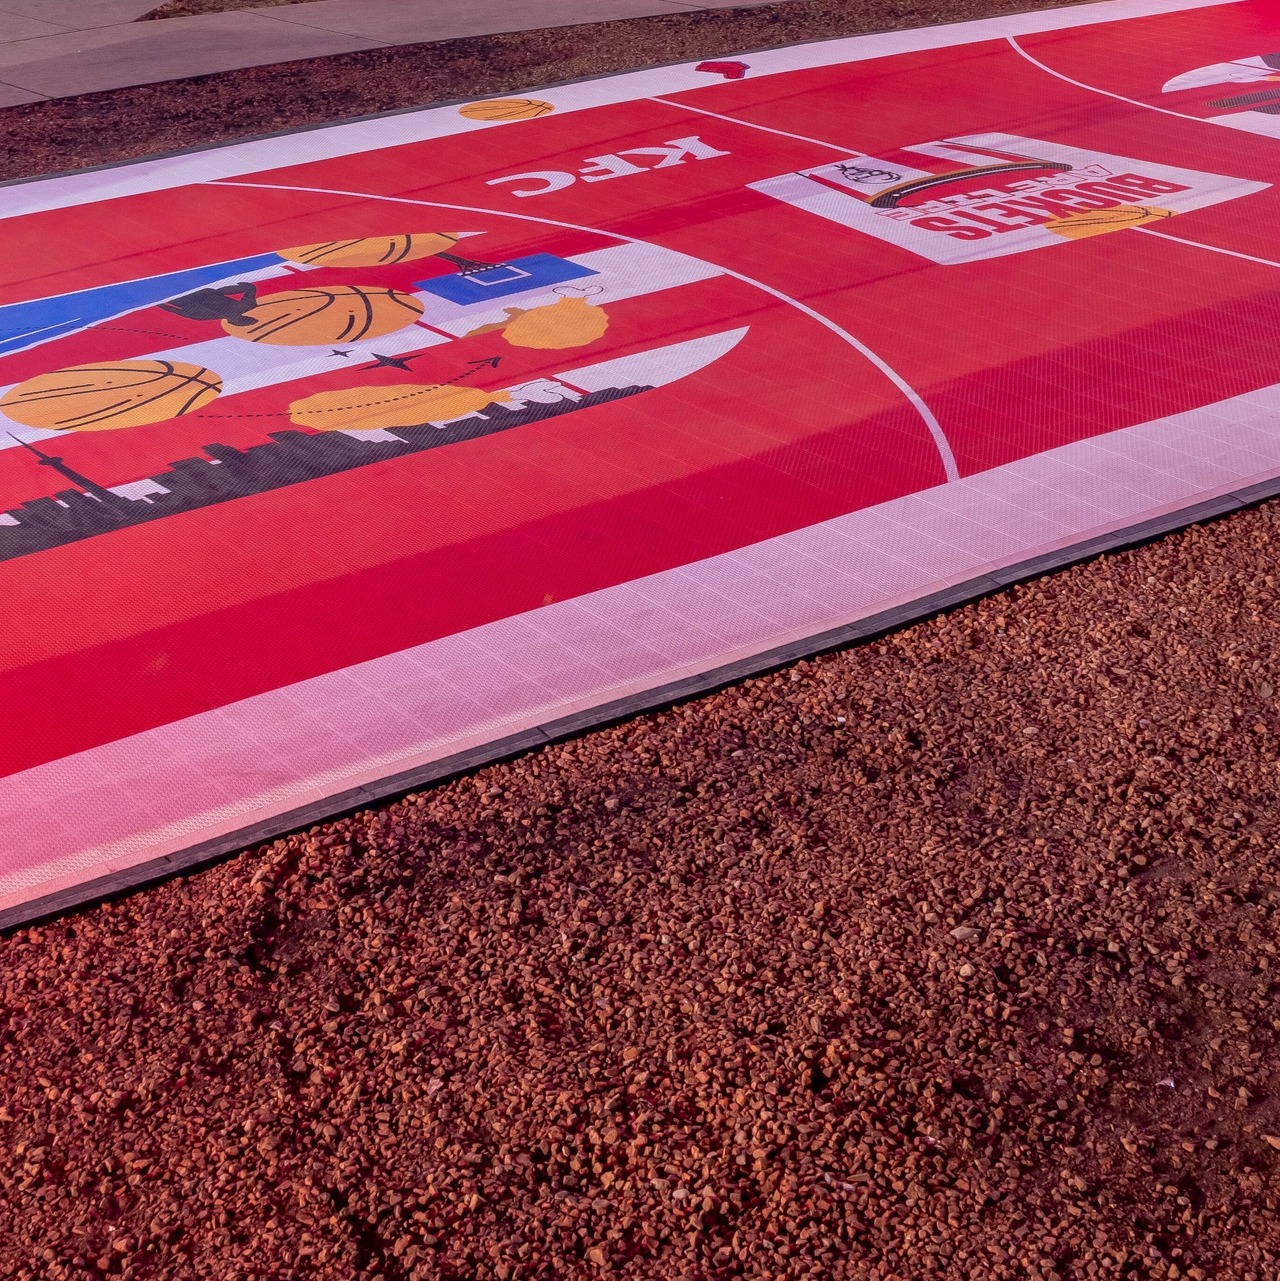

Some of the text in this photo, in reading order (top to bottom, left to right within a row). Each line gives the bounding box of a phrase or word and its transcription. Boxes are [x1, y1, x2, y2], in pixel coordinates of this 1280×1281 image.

[485, 135, 732, 198] KFC
[874, 164, 1113, 222] ARE LIFE
[910, 173, 1193, 241] BUCKETS
